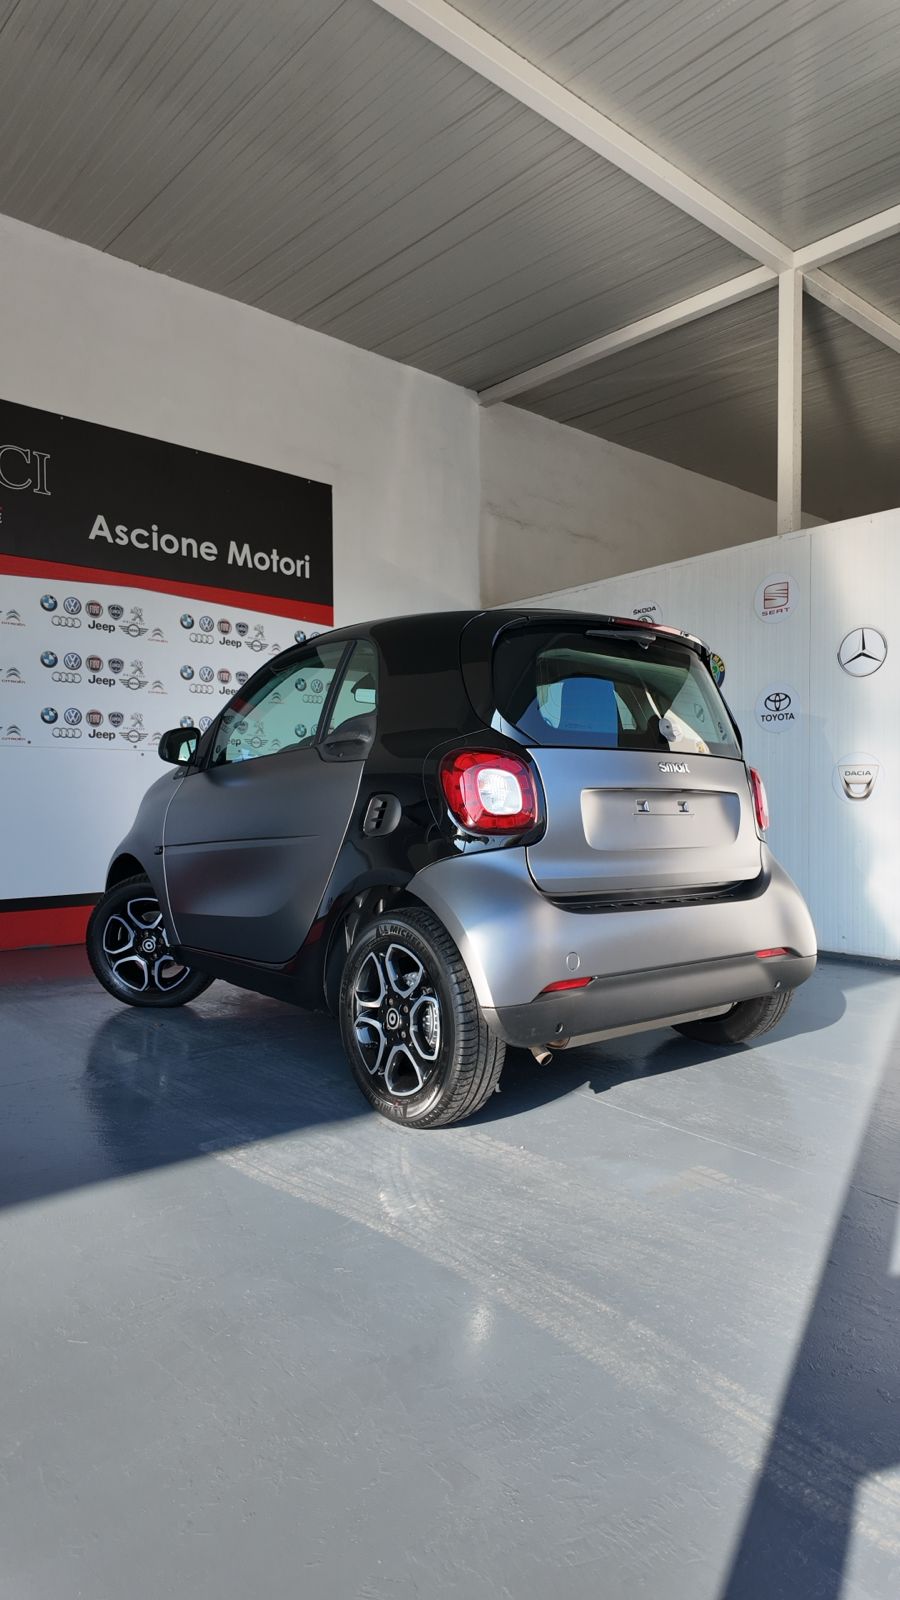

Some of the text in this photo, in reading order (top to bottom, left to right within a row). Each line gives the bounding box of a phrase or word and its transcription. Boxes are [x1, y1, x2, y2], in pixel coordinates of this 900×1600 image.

[88, 514, 311, 579] Ascione Motori
[762, 607, 790, 616] SEAT
[88, 620, 115, 633] Jeep
[219, 637, 242, 648] Jeep
[88, 675, 115, 687] Jeep
[219, 686, 240, 695] Jee
[761, 713, 795, 722] TOYOTA
[88, 729, 115, 741] Jeep
[658, 761, 690, 773] smart
